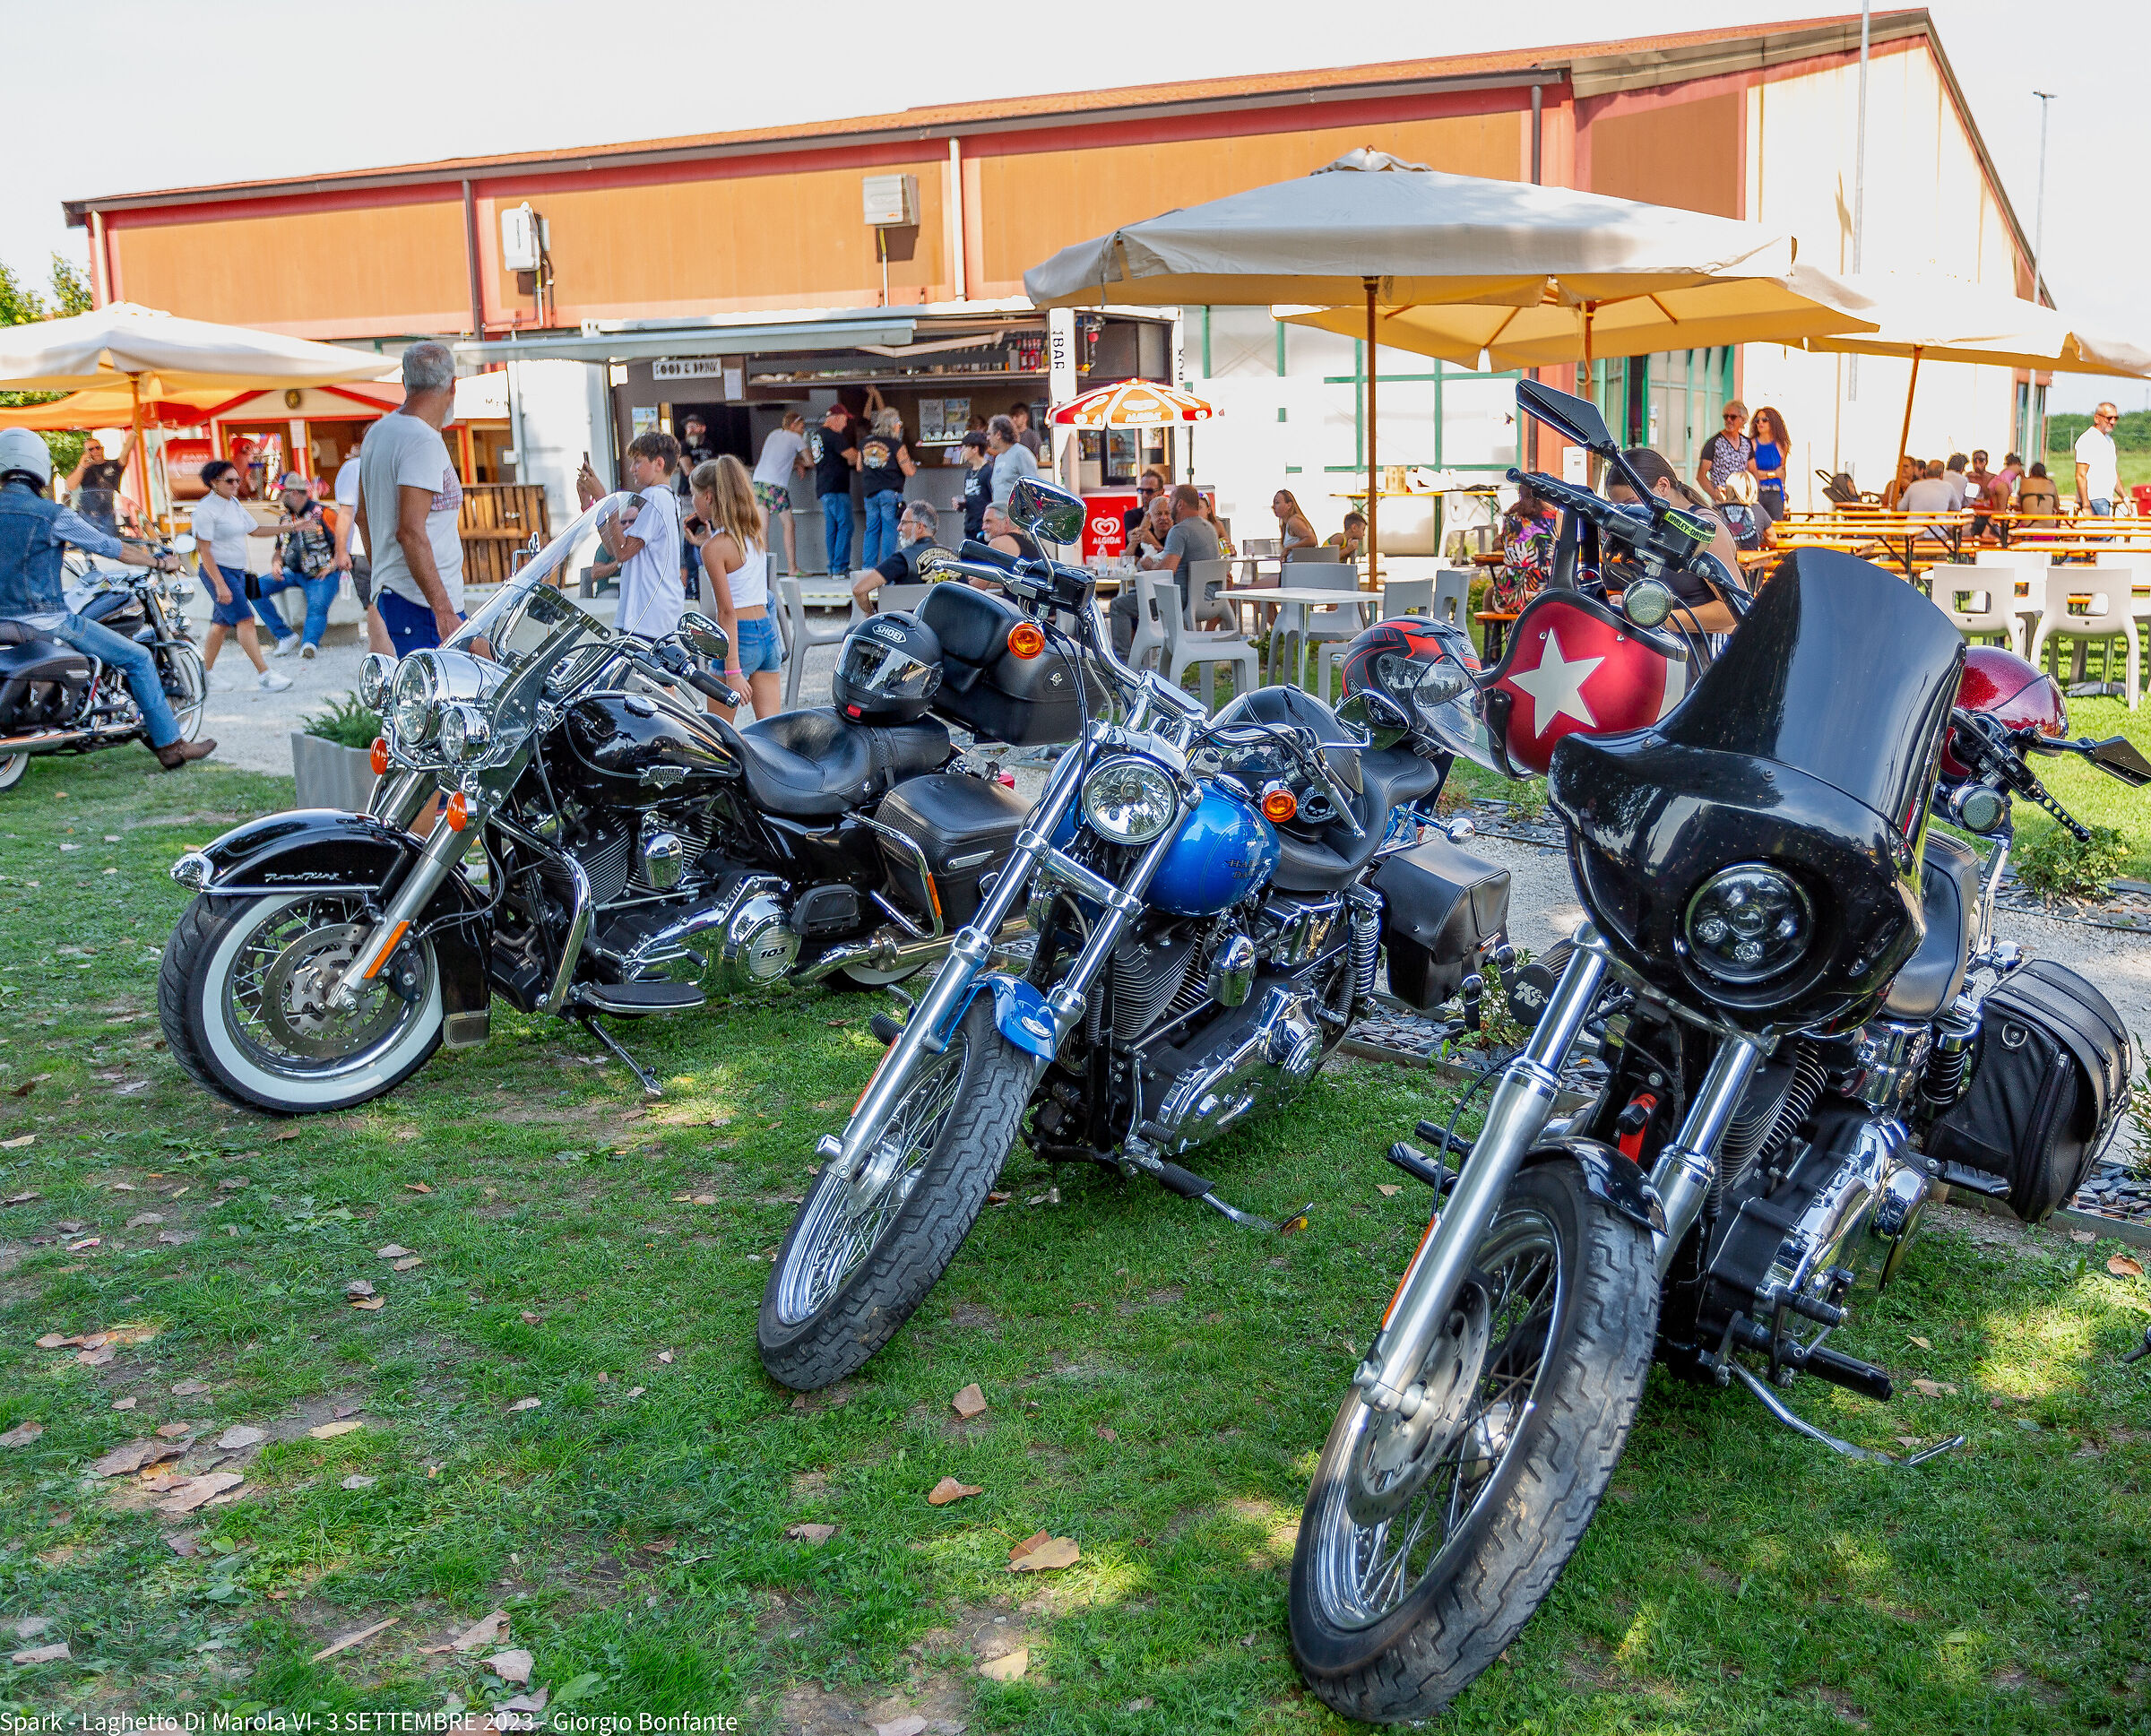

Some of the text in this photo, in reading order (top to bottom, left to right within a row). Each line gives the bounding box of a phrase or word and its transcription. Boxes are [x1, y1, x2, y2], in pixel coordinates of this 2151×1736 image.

[1092, 536, 1121, 545] ALGIDA
[875, 625, 903, 642] SHOEI
[759, 946, 787, 960] 103
[1514, 980, 1550, 1007] K&N
